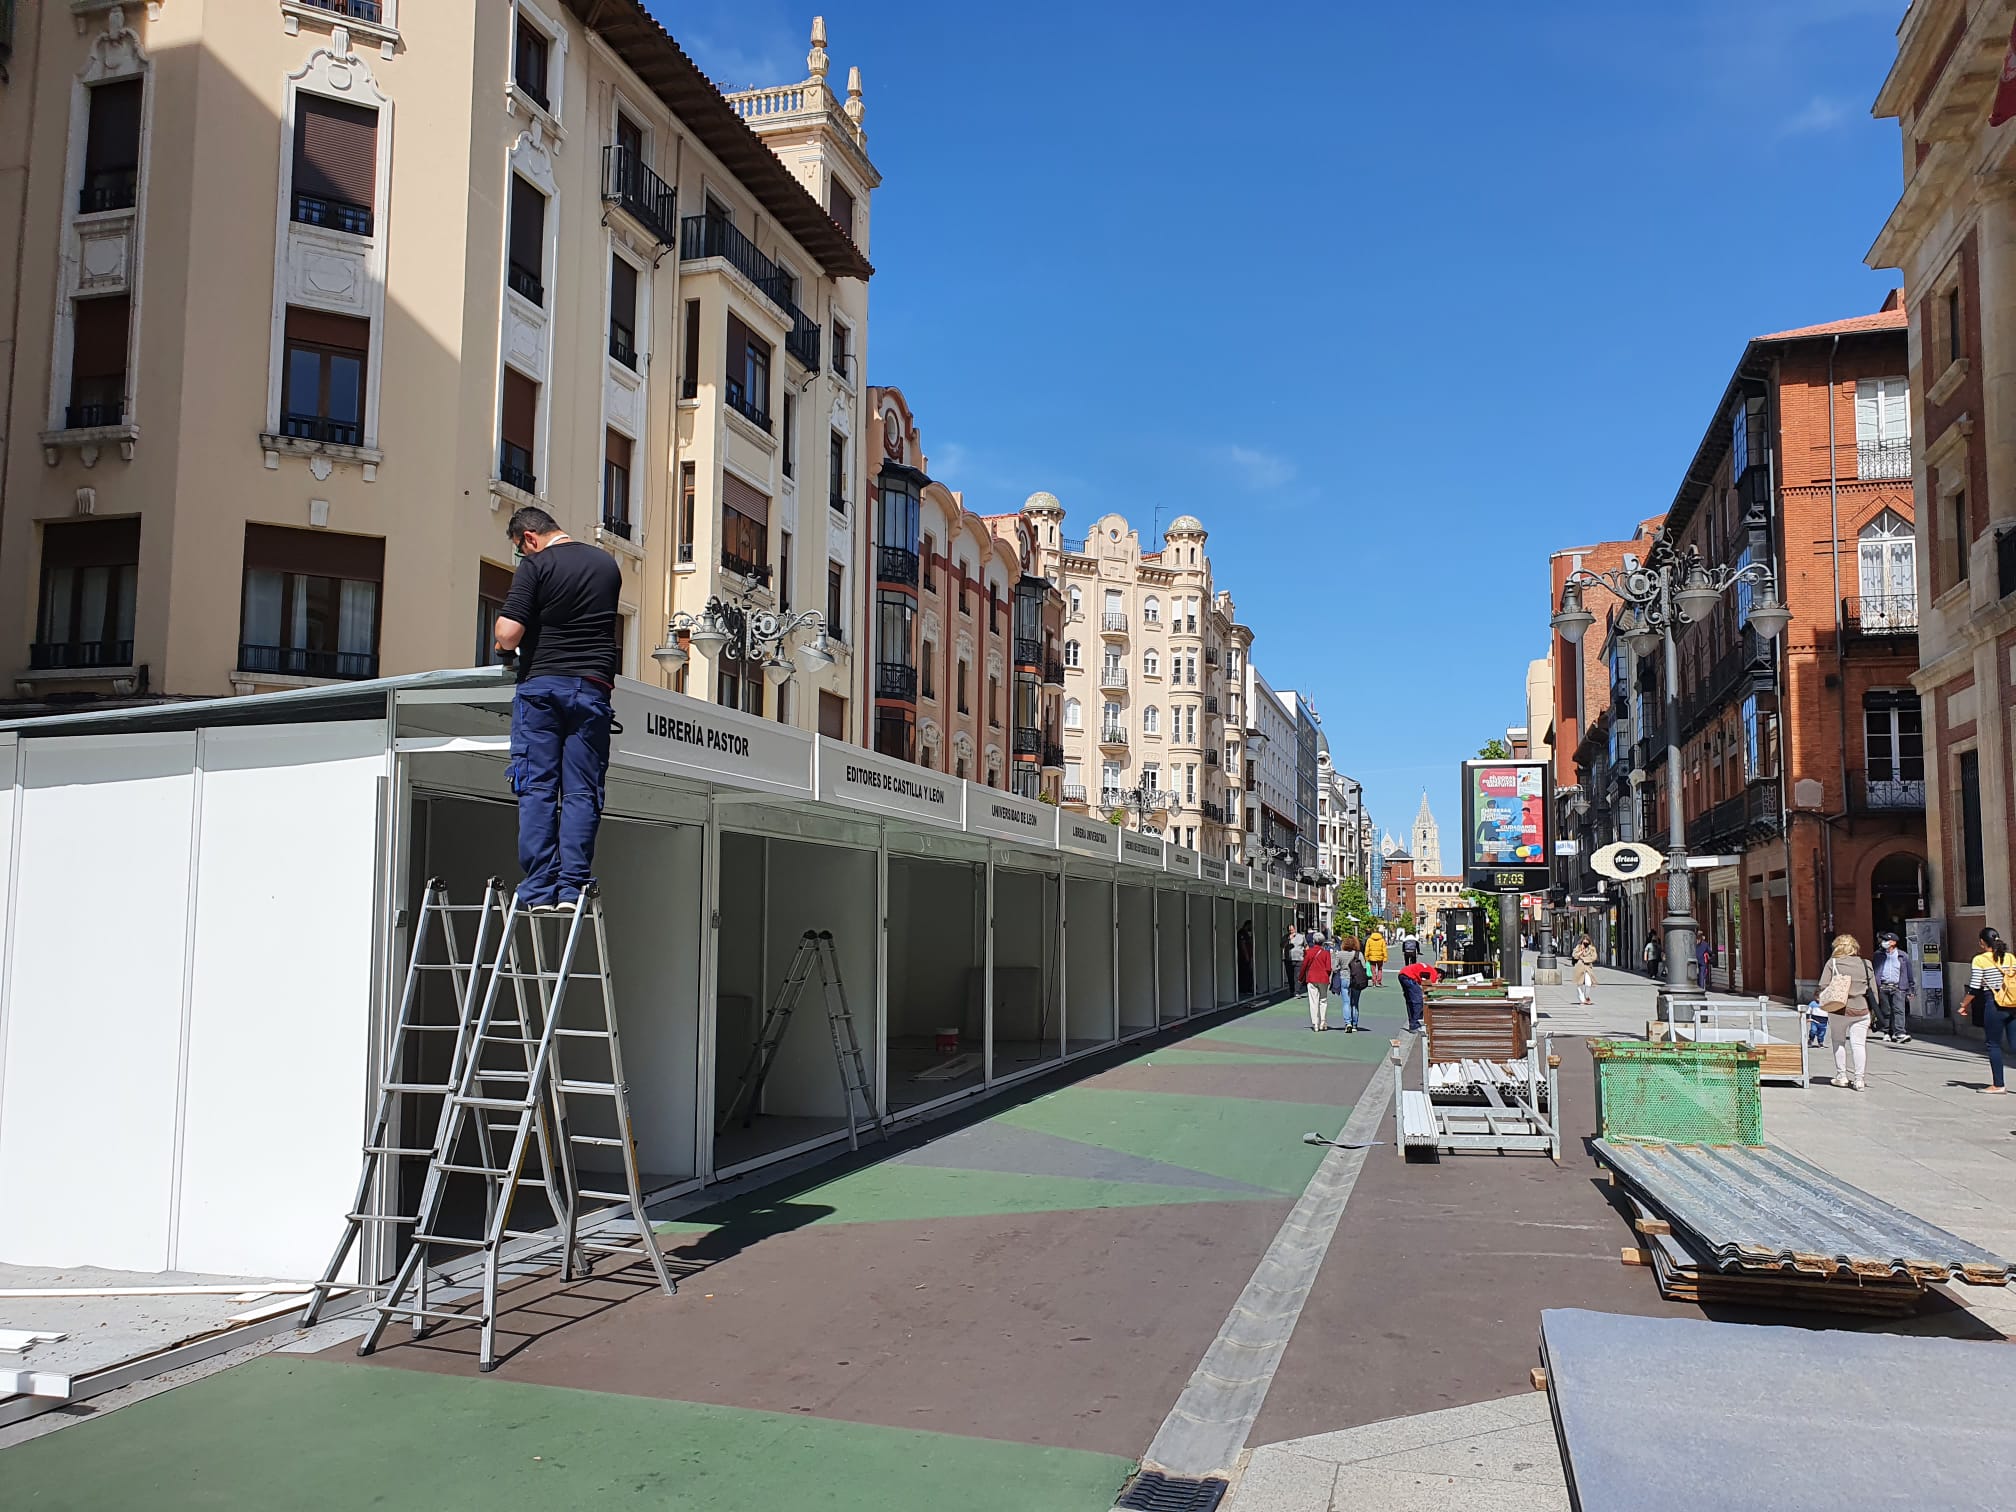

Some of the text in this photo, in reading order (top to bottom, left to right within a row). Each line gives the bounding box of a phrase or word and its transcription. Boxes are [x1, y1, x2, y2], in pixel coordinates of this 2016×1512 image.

[647, 712, 749, 757] LIBRERÍA PASTOR
[846, 765, 945, 804] EDITORES DE CASTILLA Y LEÓN
[991, 804, 1020, 822] UNIVERSIDAD
[1020, 811, 1026, 824] DE
[1497, 873, 1524, 884] 17:03
